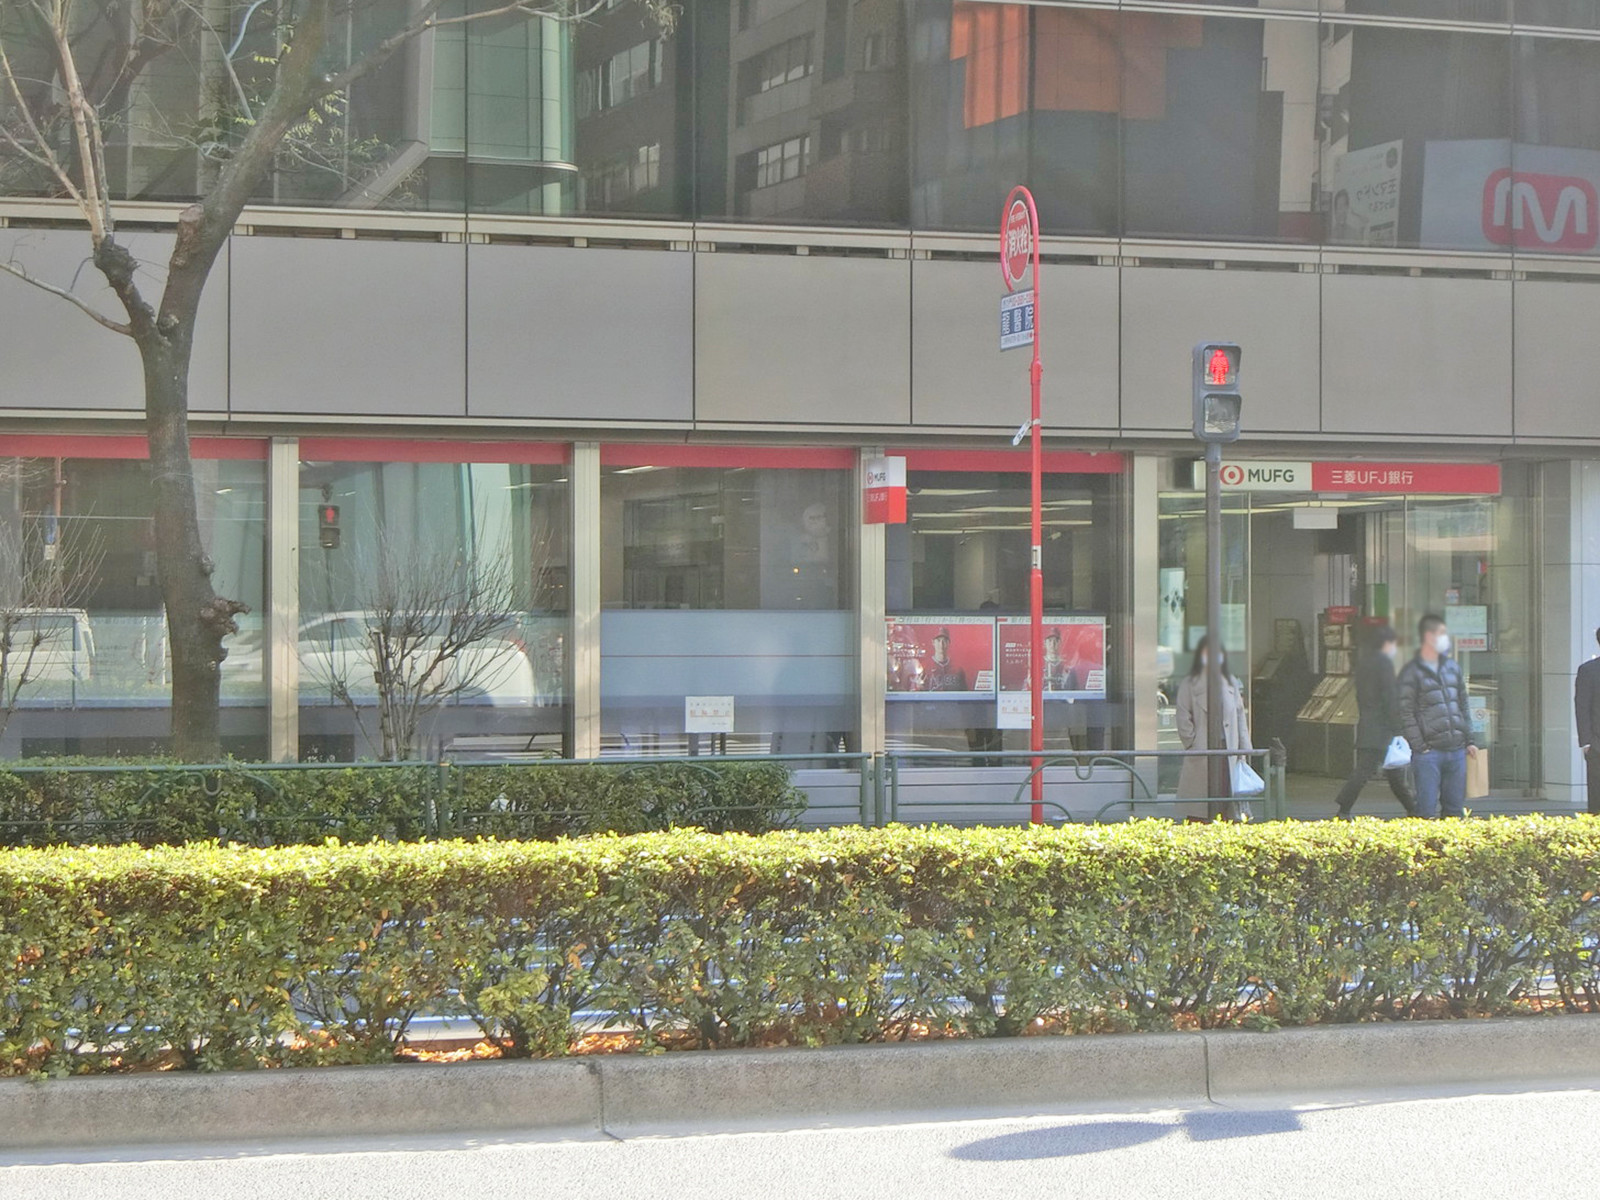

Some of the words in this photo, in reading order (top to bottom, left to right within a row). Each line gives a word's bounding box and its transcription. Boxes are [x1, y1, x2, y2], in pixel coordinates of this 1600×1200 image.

[1008, 225, 1028, 258] 消火栓
[1247, 468, 1295, 483] MUFG
[1331, 470, 1414, 485] 三菱UFJ銀行
